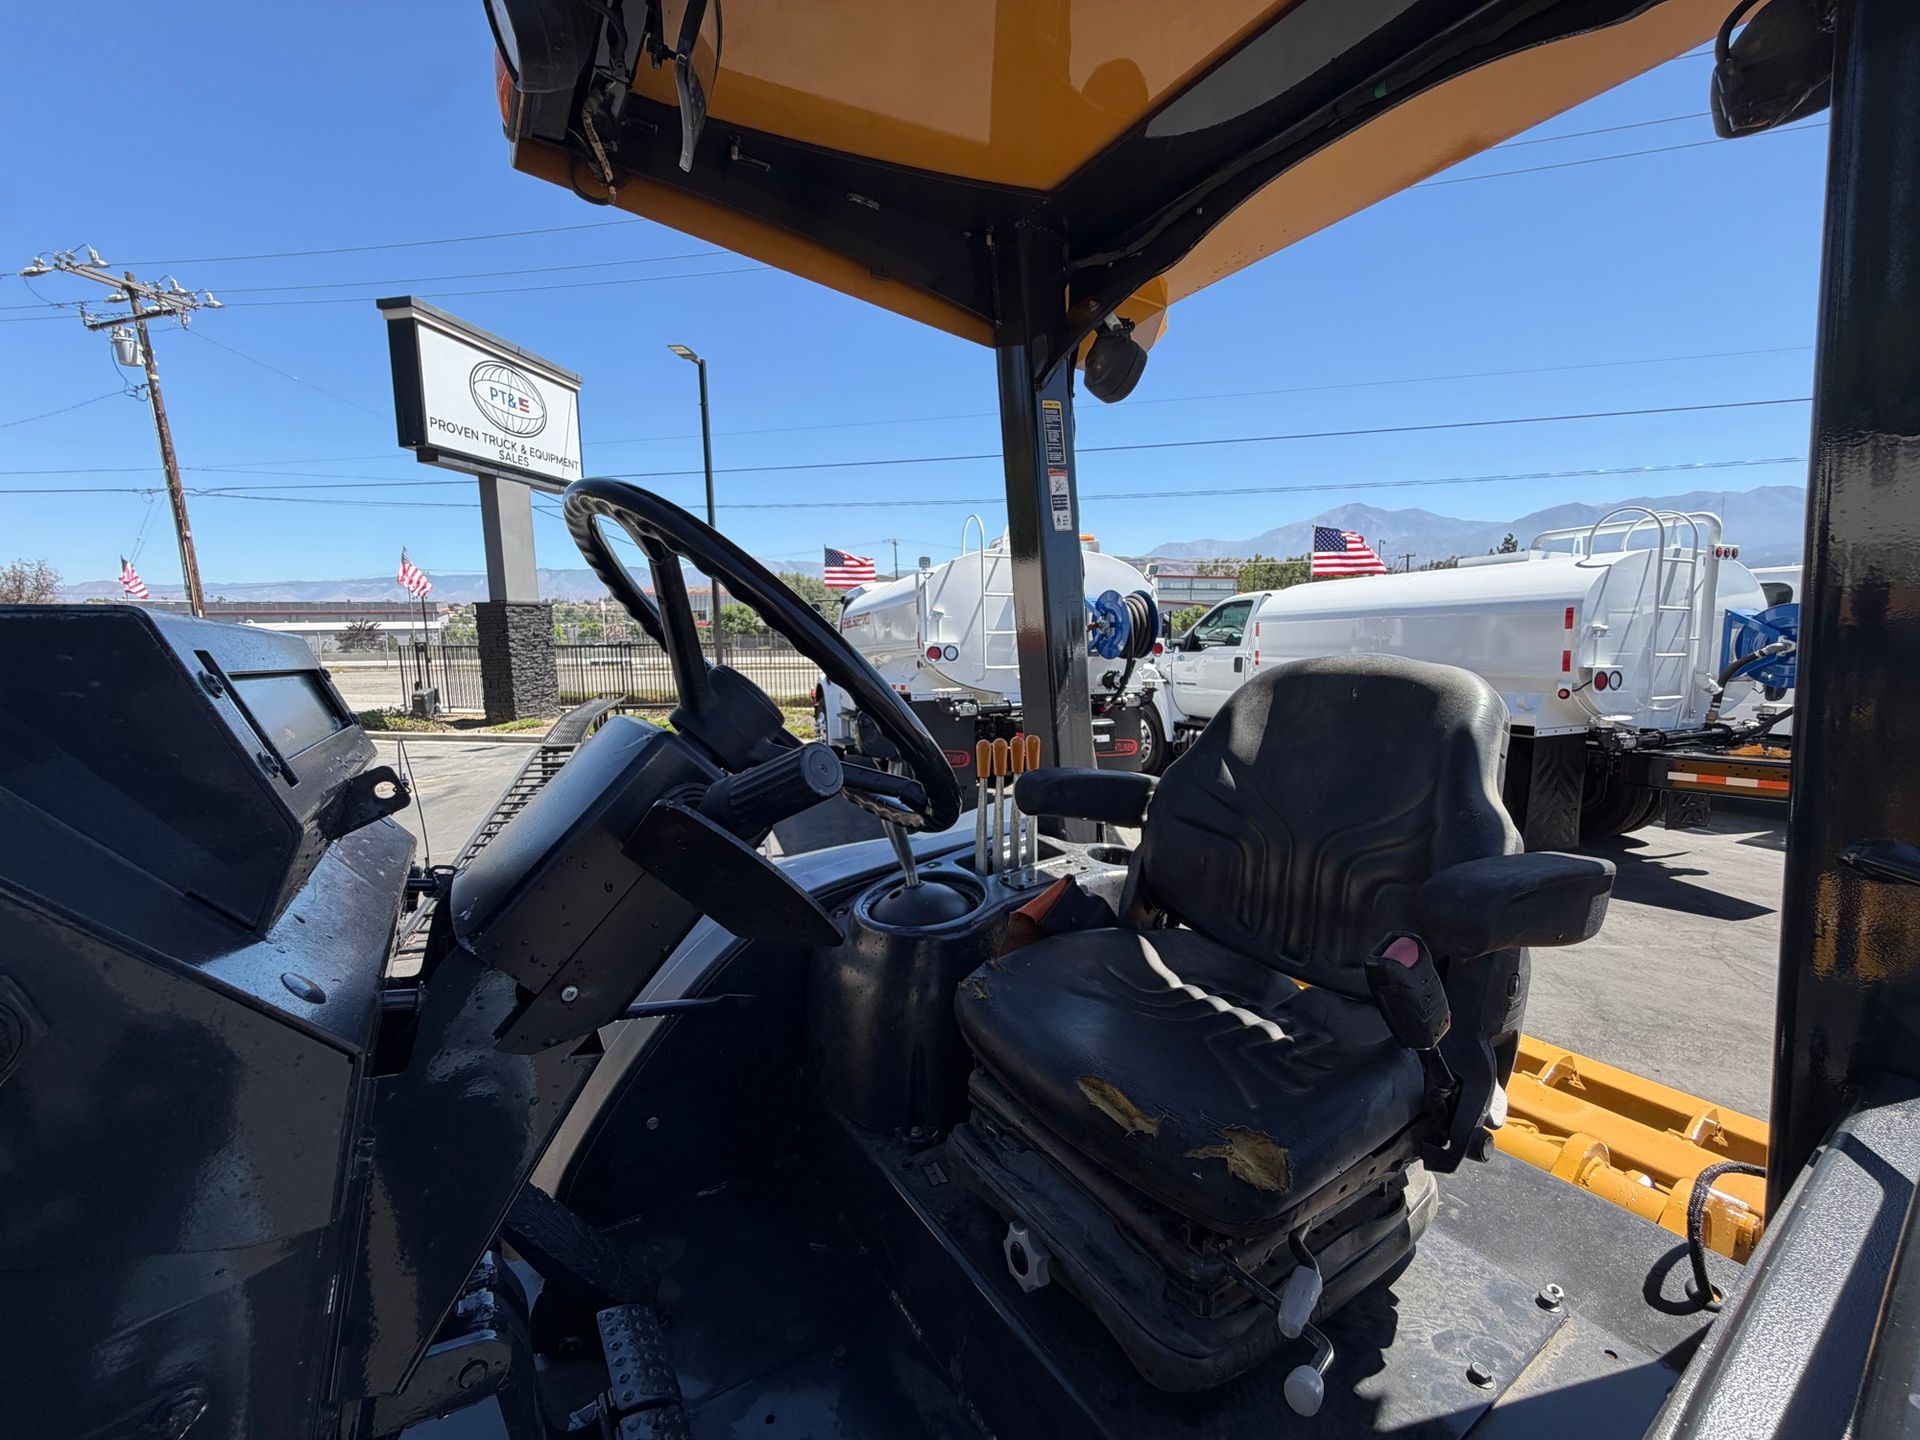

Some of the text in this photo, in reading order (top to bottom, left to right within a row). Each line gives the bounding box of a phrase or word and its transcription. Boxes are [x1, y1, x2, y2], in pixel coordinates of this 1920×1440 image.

[491, 387, 529, 413] PT&E
[430, 417, 578, 470] PROVEN TRUCK & EQUIPMENT
[500, 450, 529, 466] SALES
